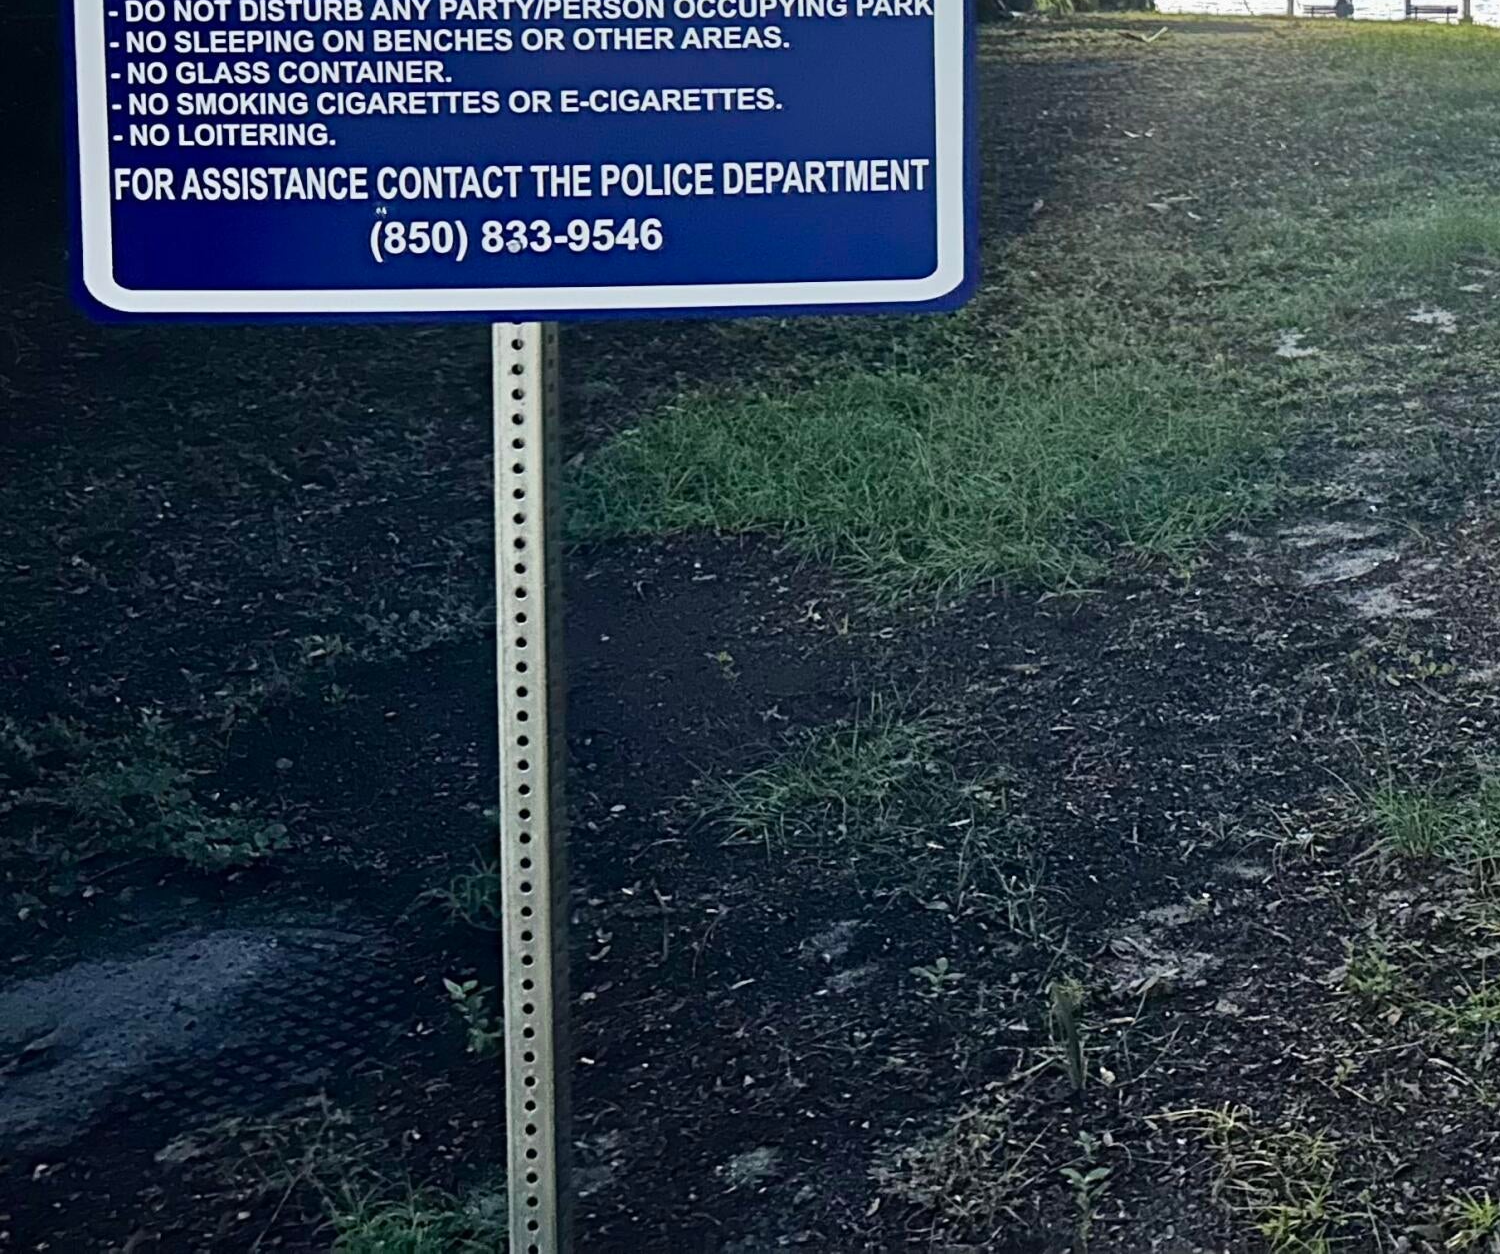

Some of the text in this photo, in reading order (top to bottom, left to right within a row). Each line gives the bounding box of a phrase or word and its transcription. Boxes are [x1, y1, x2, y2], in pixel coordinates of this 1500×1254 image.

[125, 0, 165, 22] DO
[174, 0, 231, 21] NOT
[240, 0, 363, 21] DISTURB
[127, 31, 166, 52] NO
[175, 30, 314, 53] SLEEPING
[323, 30, 363, 52] ON
[374, 29, 512, 51] BENCHES
[522, 29, 565, 50] OR
[573, 28, 674, 50] OTHER
[681, 26, 789, 49] AREAS.
[128, 62, 167, 84] NO
[176, 61, 270, 84] GLASS
[279, 61, 451, 83] CONTAINER.
[129, 93, 168, 115] NO
[177, 92, 308, 115] SMOKING
[317, 91, 500, 114] CIGARETTES
[509, 91, 552, 113] OR
[561, 87, 782, 112] E-CIGARETTES.
[130, 124, 169, 146] NO
[178, 123, 335, 146] LOITERING.
[115, 159, 929, 200] FOR ASSISTANCE CONTACT THE POLICE DEPARTMENT
[371, 218, 662, 262] (850) 833-9546
